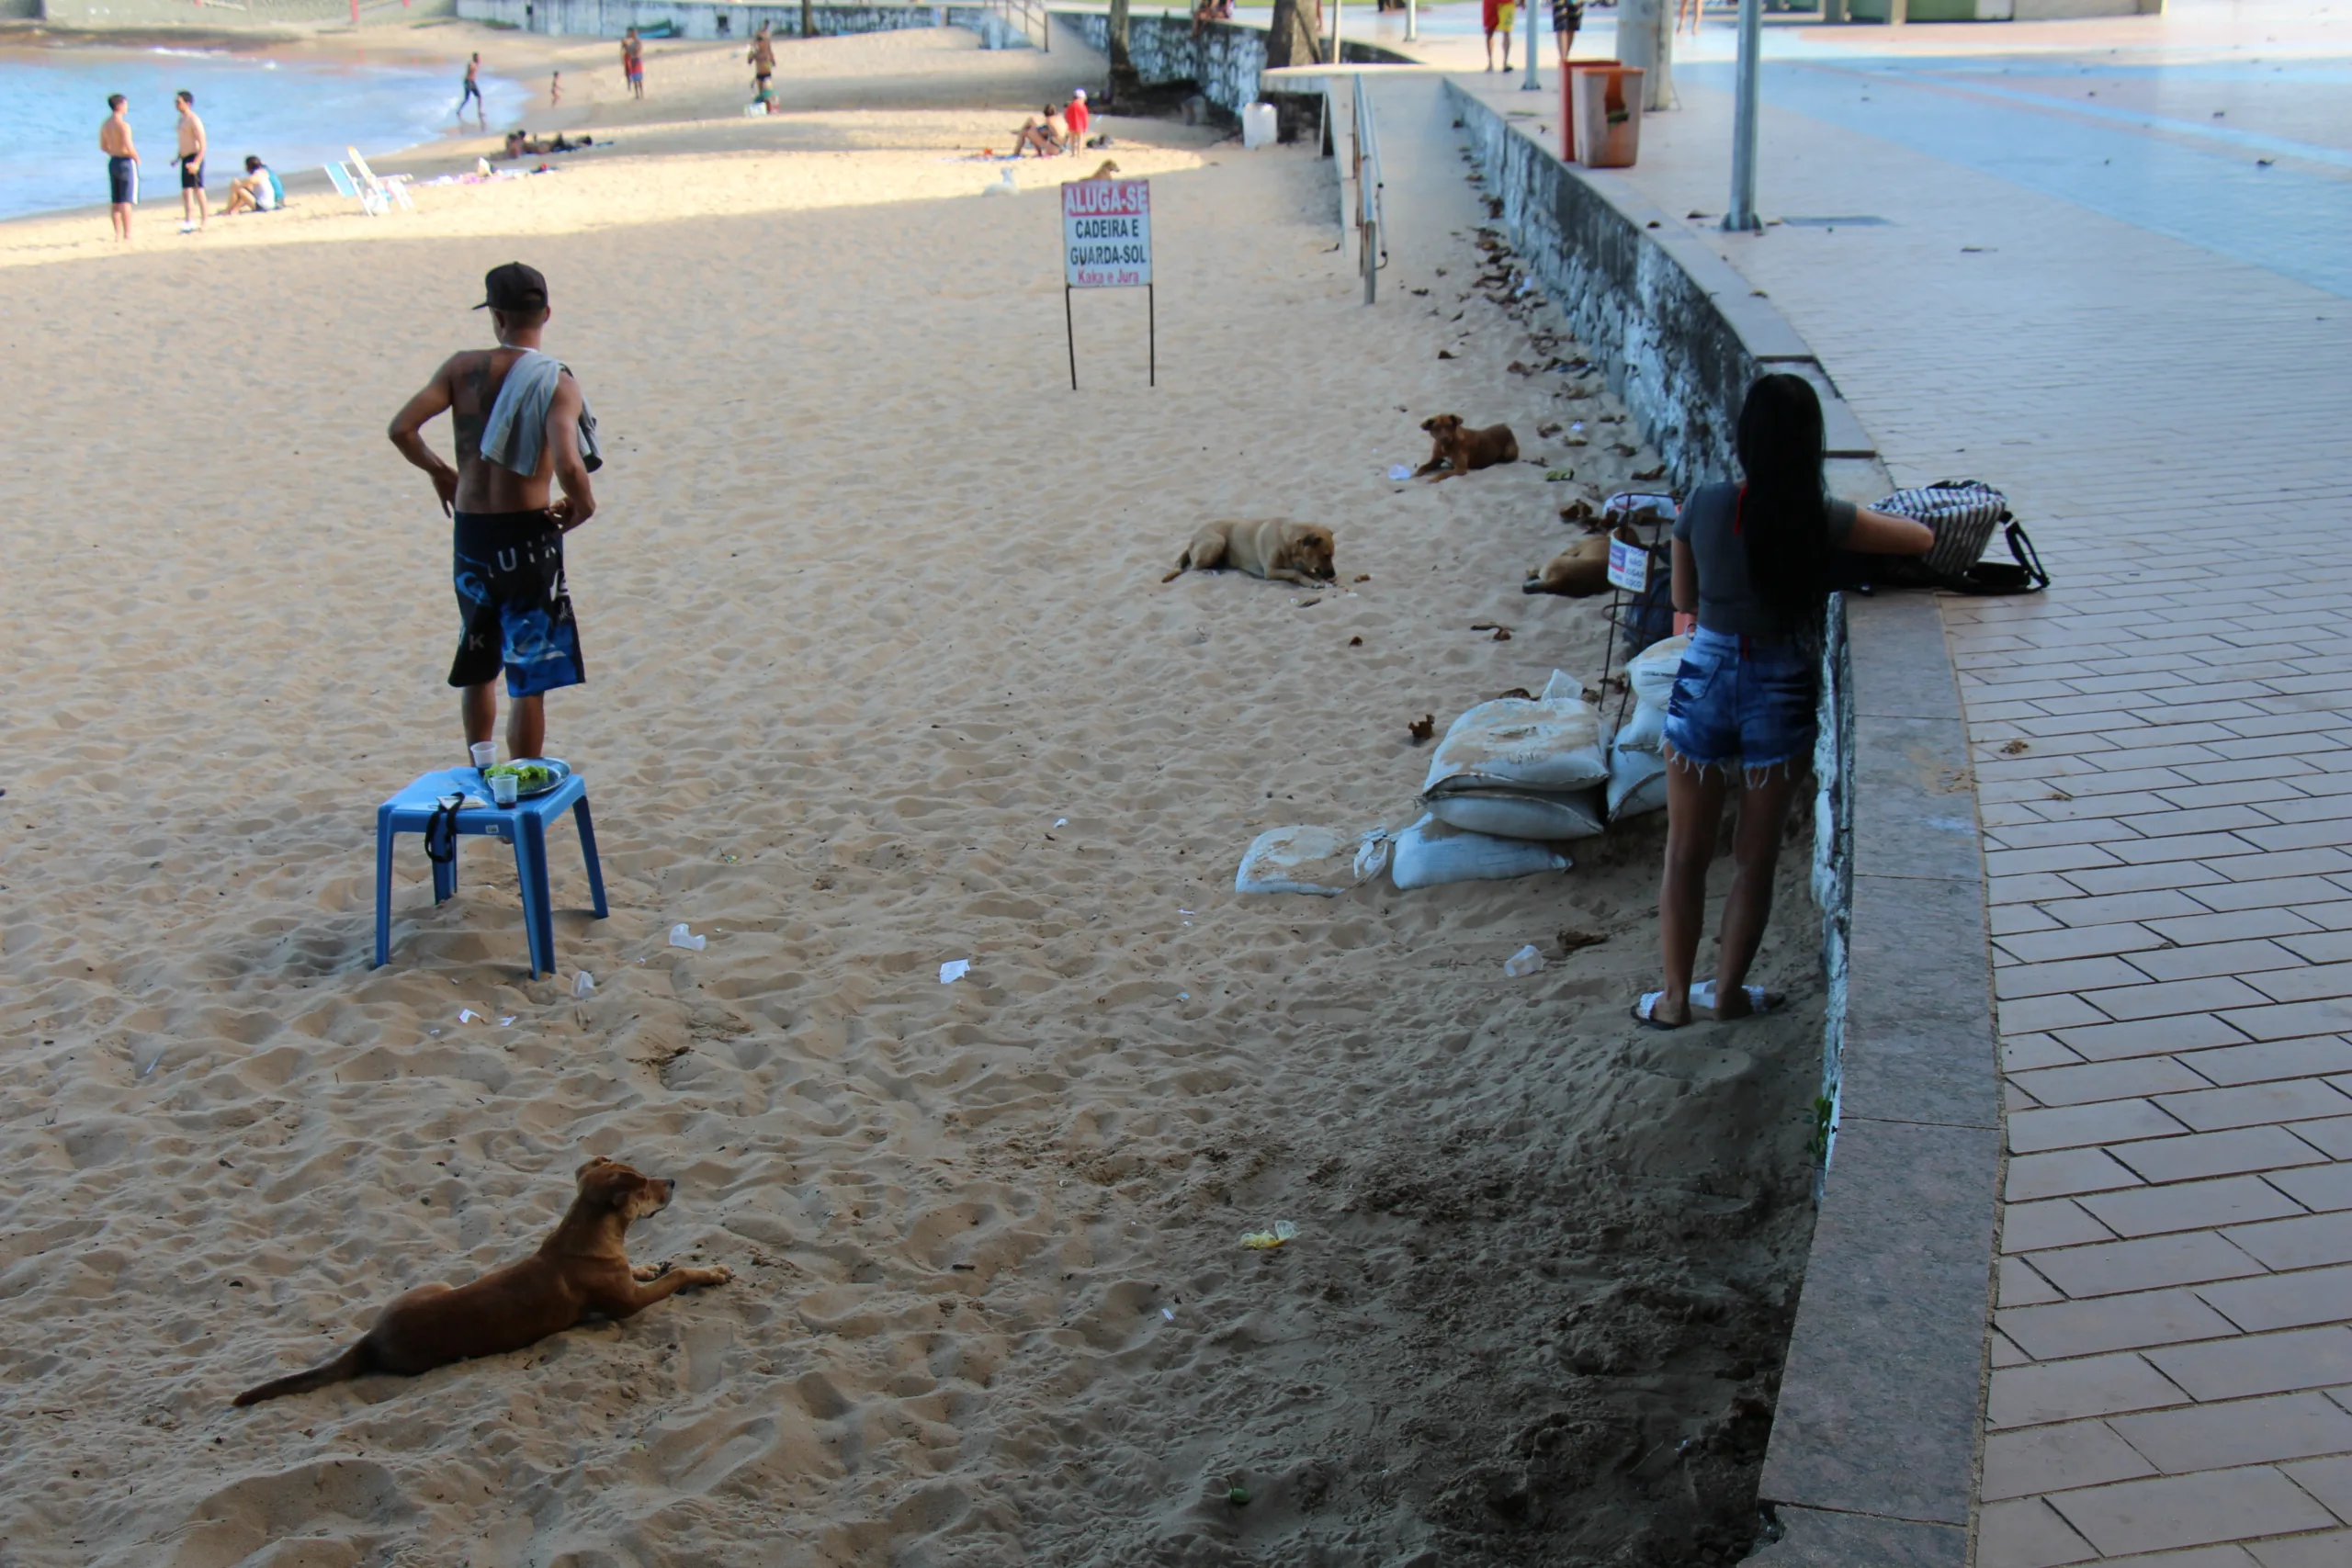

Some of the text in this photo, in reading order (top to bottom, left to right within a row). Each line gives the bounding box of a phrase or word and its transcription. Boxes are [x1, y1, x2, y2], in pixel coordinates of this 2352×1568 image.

[1066, 186, 1148, 213] ALUGA-SE
[1075, 219, 1139, 239] CADEIRA E
[1070, 244, 1147, 265] GUARDA-SOL
